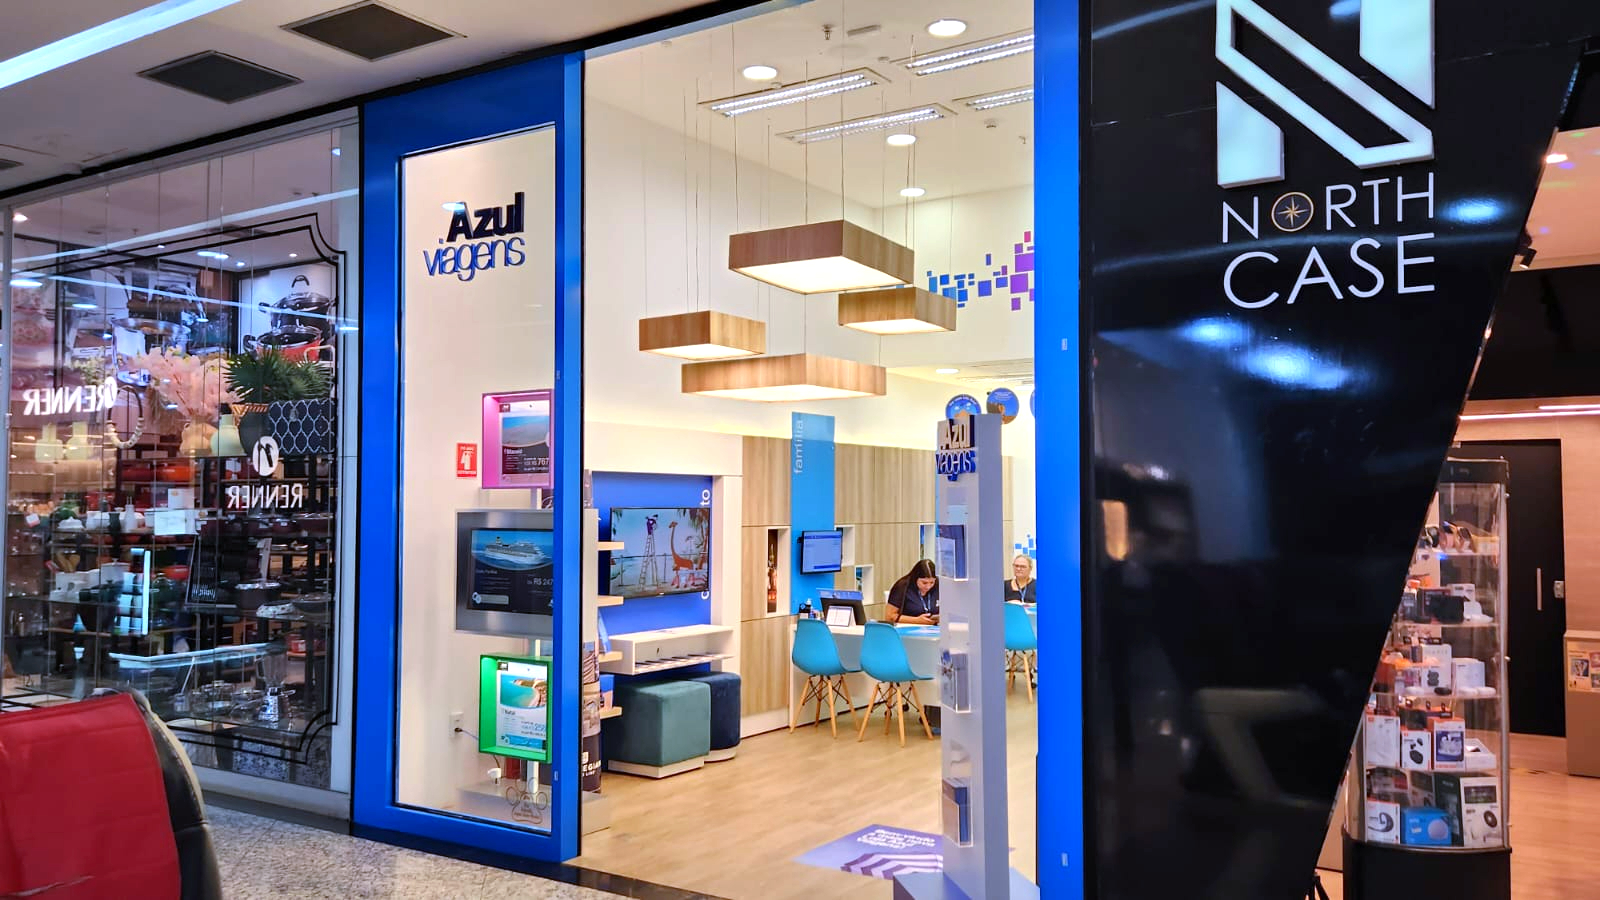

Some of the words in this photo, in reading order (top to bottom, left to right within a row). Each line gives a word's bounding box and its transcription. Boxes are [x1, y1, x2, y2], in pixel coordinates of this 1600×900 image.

[446, 191, 525, 243] Azul
[423, 236, 526, 282] viagens
[1223, 232, 1436, 309] CASE
[940, 414, 976, 450] Azul
[935, 448, 977, 482] viagens
